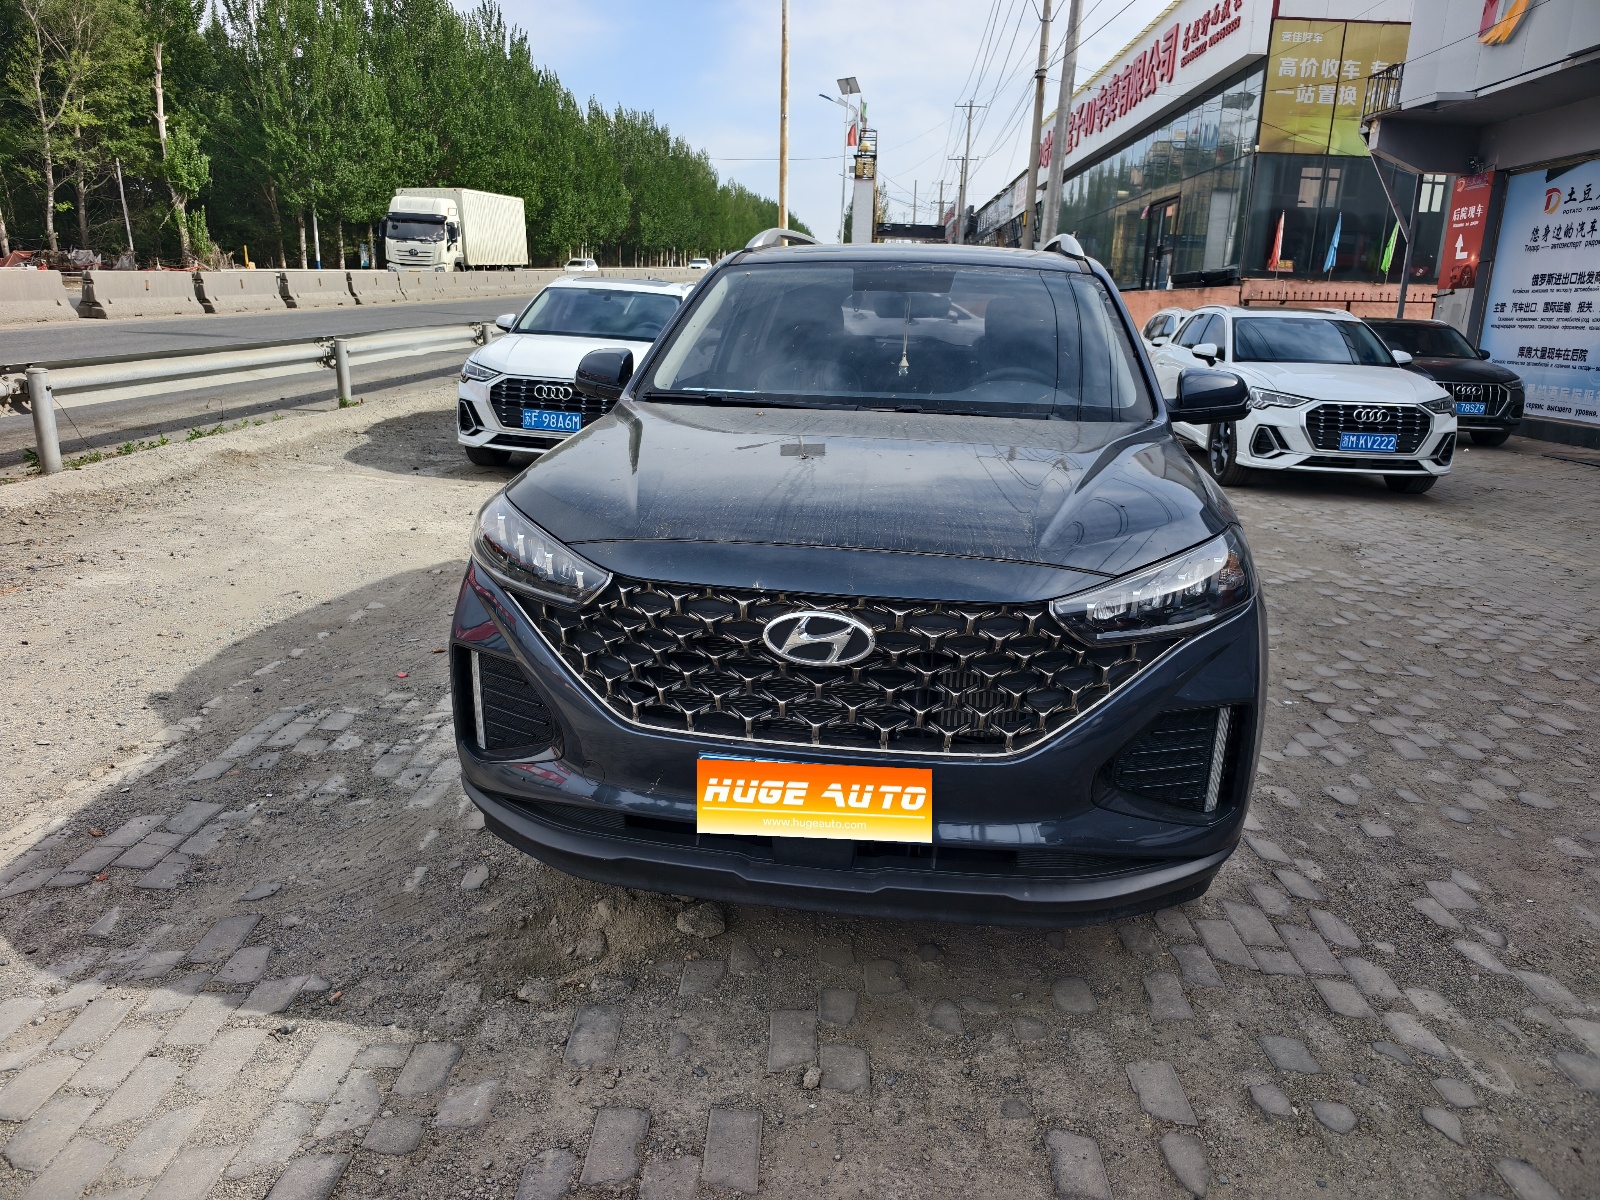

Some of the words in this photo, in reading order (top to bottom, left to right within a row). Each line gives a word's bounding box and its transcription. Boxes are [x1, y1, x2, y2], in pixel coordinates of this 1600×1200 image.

[1278, 57, 1361, 79] 高价收车
[1276, 84, 1357, 105] 一站置换
[1564, 184, 1600, 204] 土豆
[1453, 204, 1483, 221] 后院现车
[1517, 346, 1588, 362] 库房大量现车在后院
